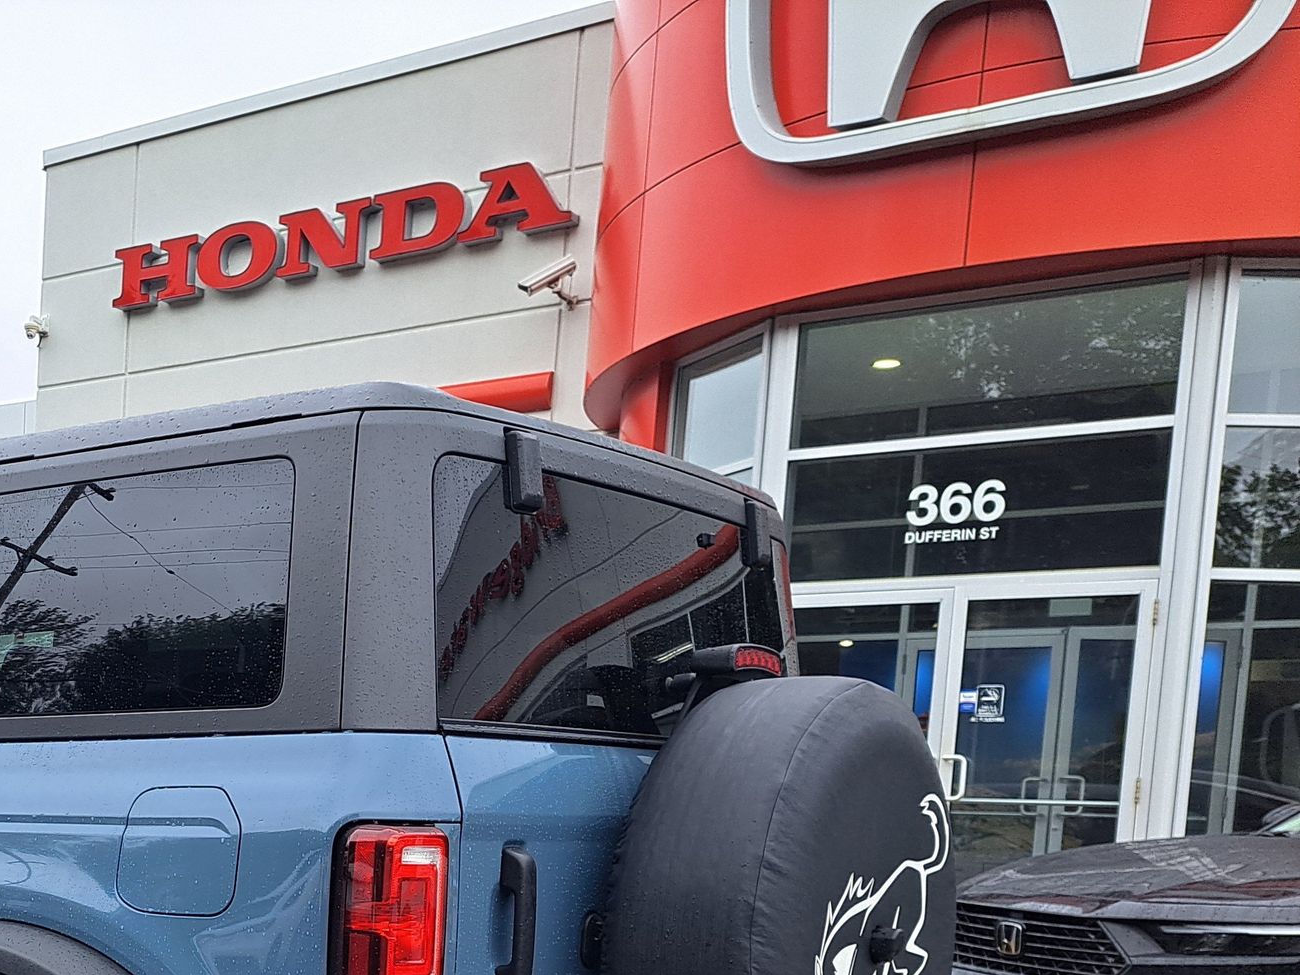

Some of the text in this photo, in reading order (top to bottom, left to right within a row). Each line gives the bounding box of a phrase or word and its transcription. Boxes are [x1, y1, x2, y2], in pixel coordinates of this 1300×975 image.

[112, 162, 579, 312] HONDA
[906, 479, 1006, 526] 366
[904, 526, 1000, 544] DUFFERIN ST
